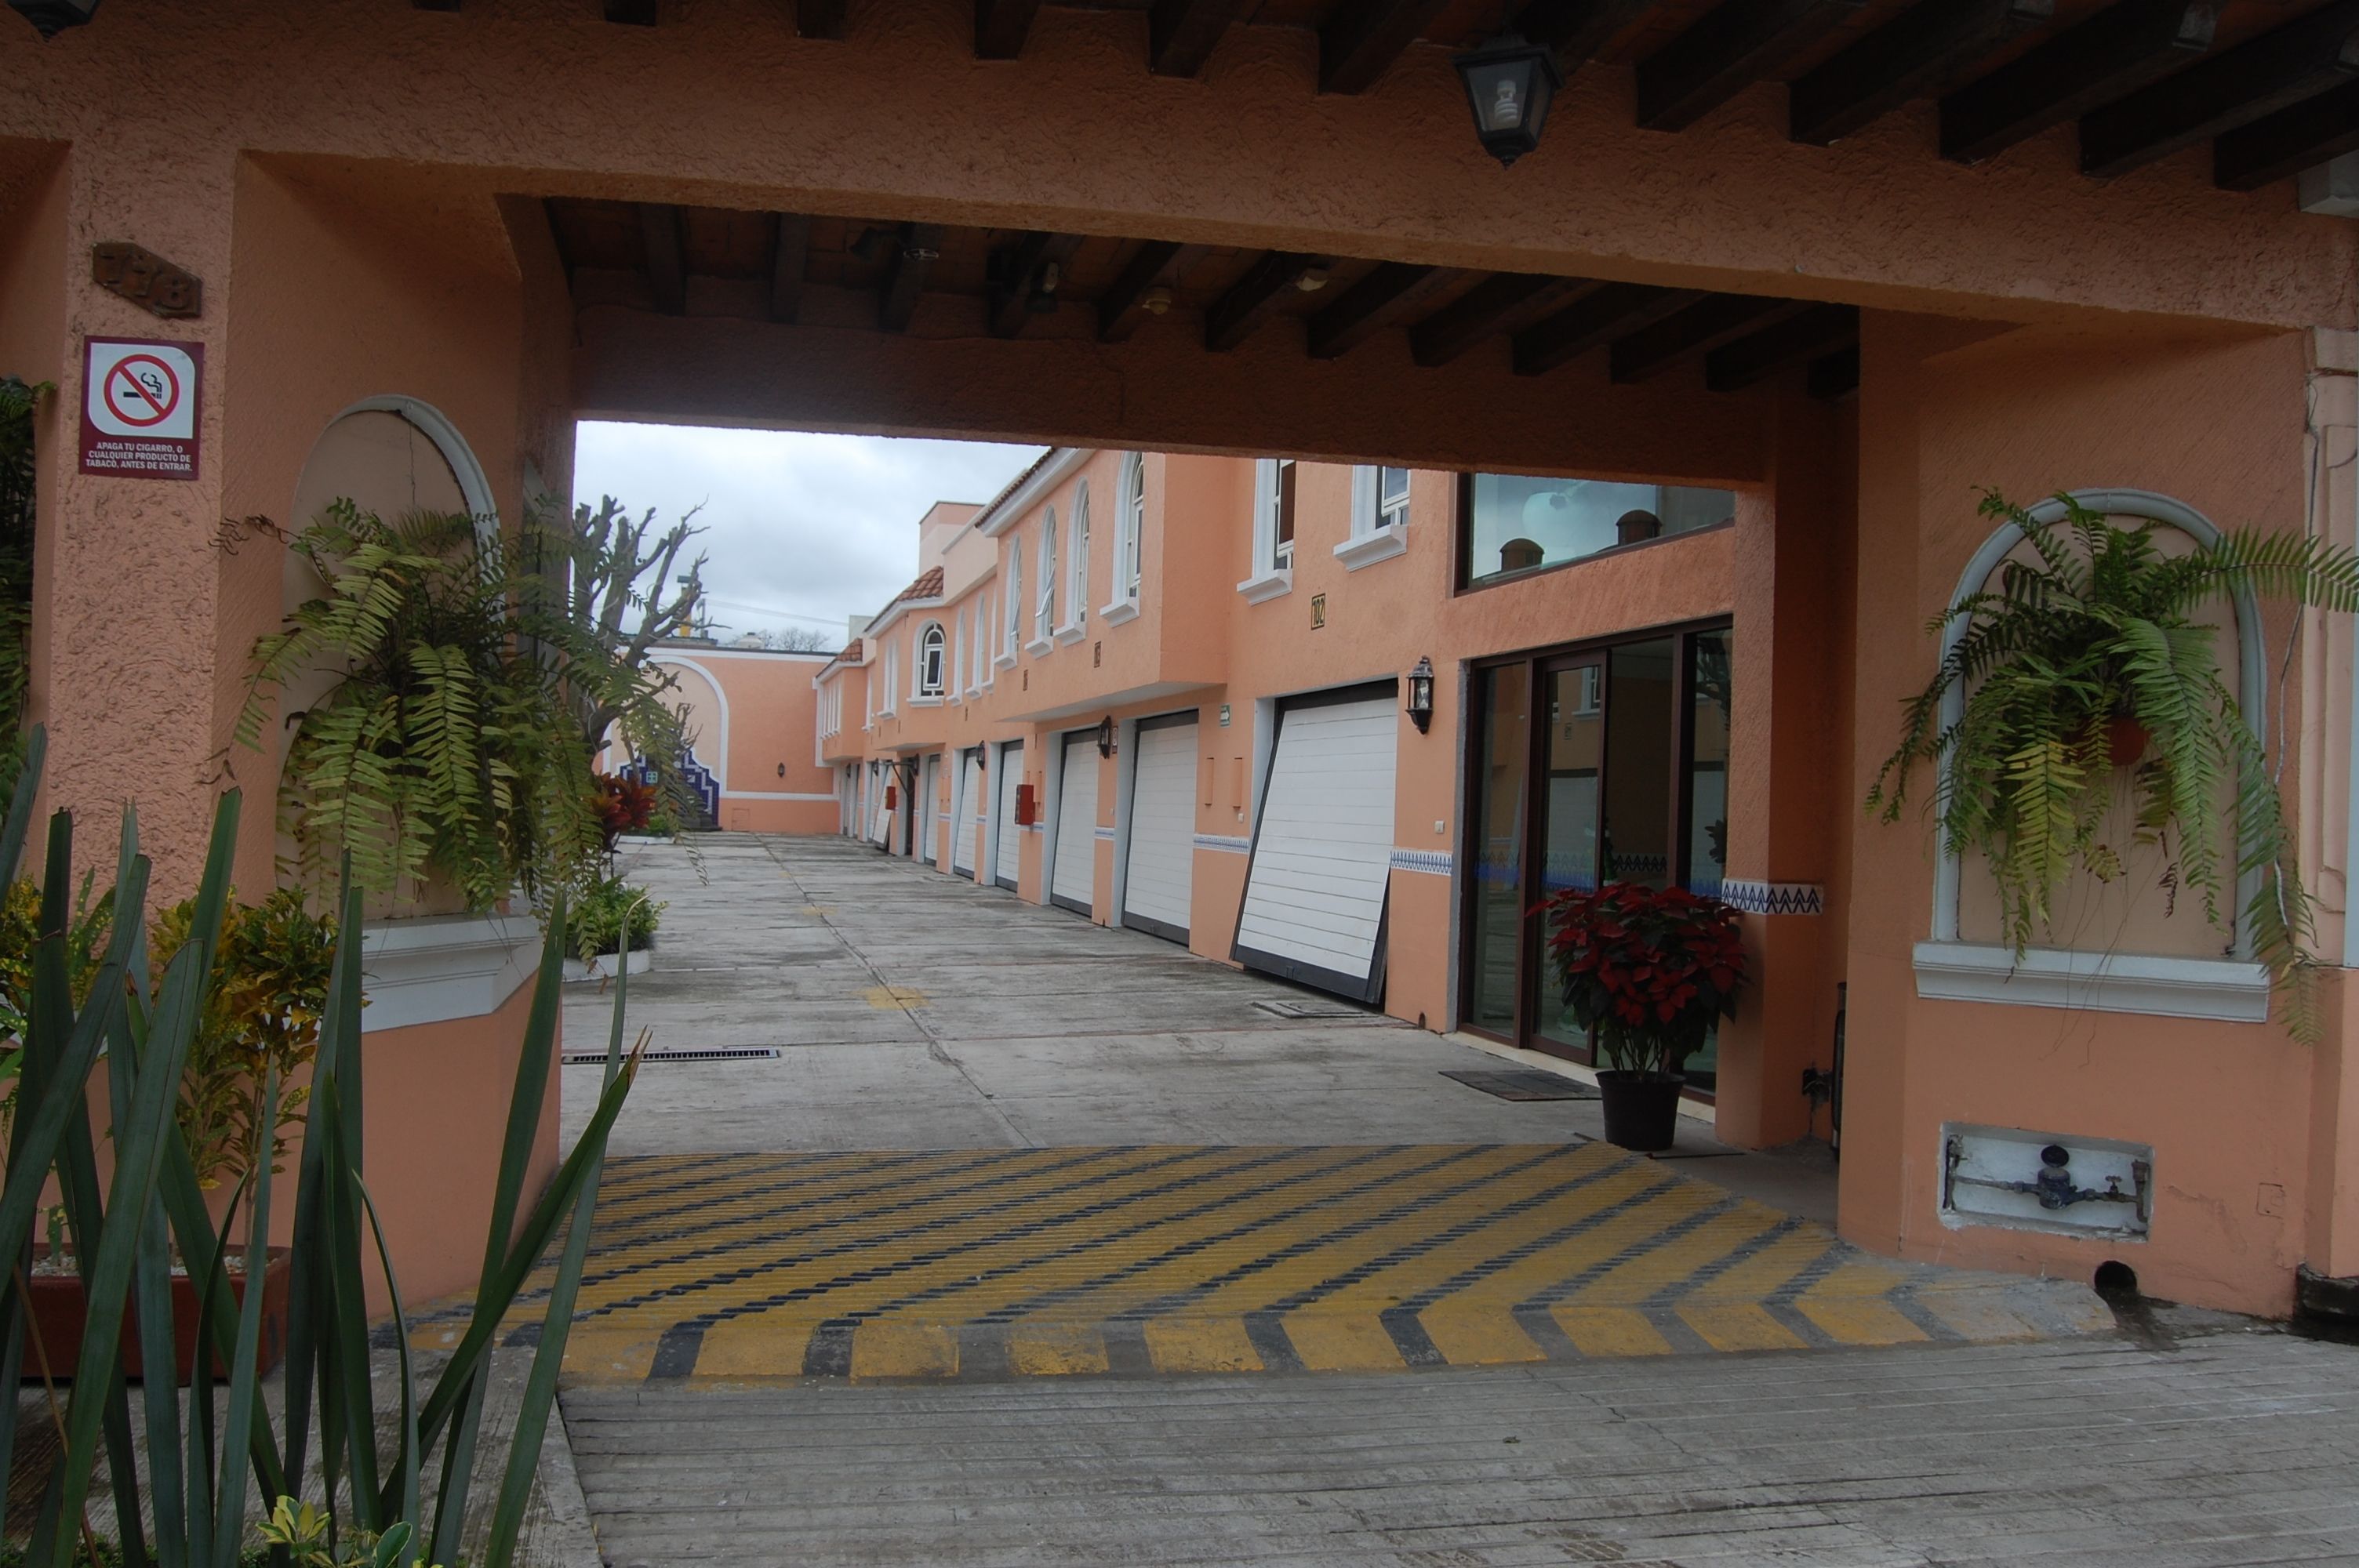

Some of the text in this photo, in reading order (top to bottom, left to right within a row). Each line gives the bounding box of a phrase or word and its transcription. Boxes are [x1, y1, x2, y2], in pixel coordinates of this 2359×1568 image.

[96, 442, 124, 451] APAGA
[136, 444, 176, 453] CIGARRO,
[88, 450, 191, 463] CUALQUIER PRODUCTO DE
[85, 459, 119, 469] TABACO,
[147, 462, 158, 470] DE
[158, 463, 193, 471] ENTRAR.
[1313, 597, 1325, 626] 102
